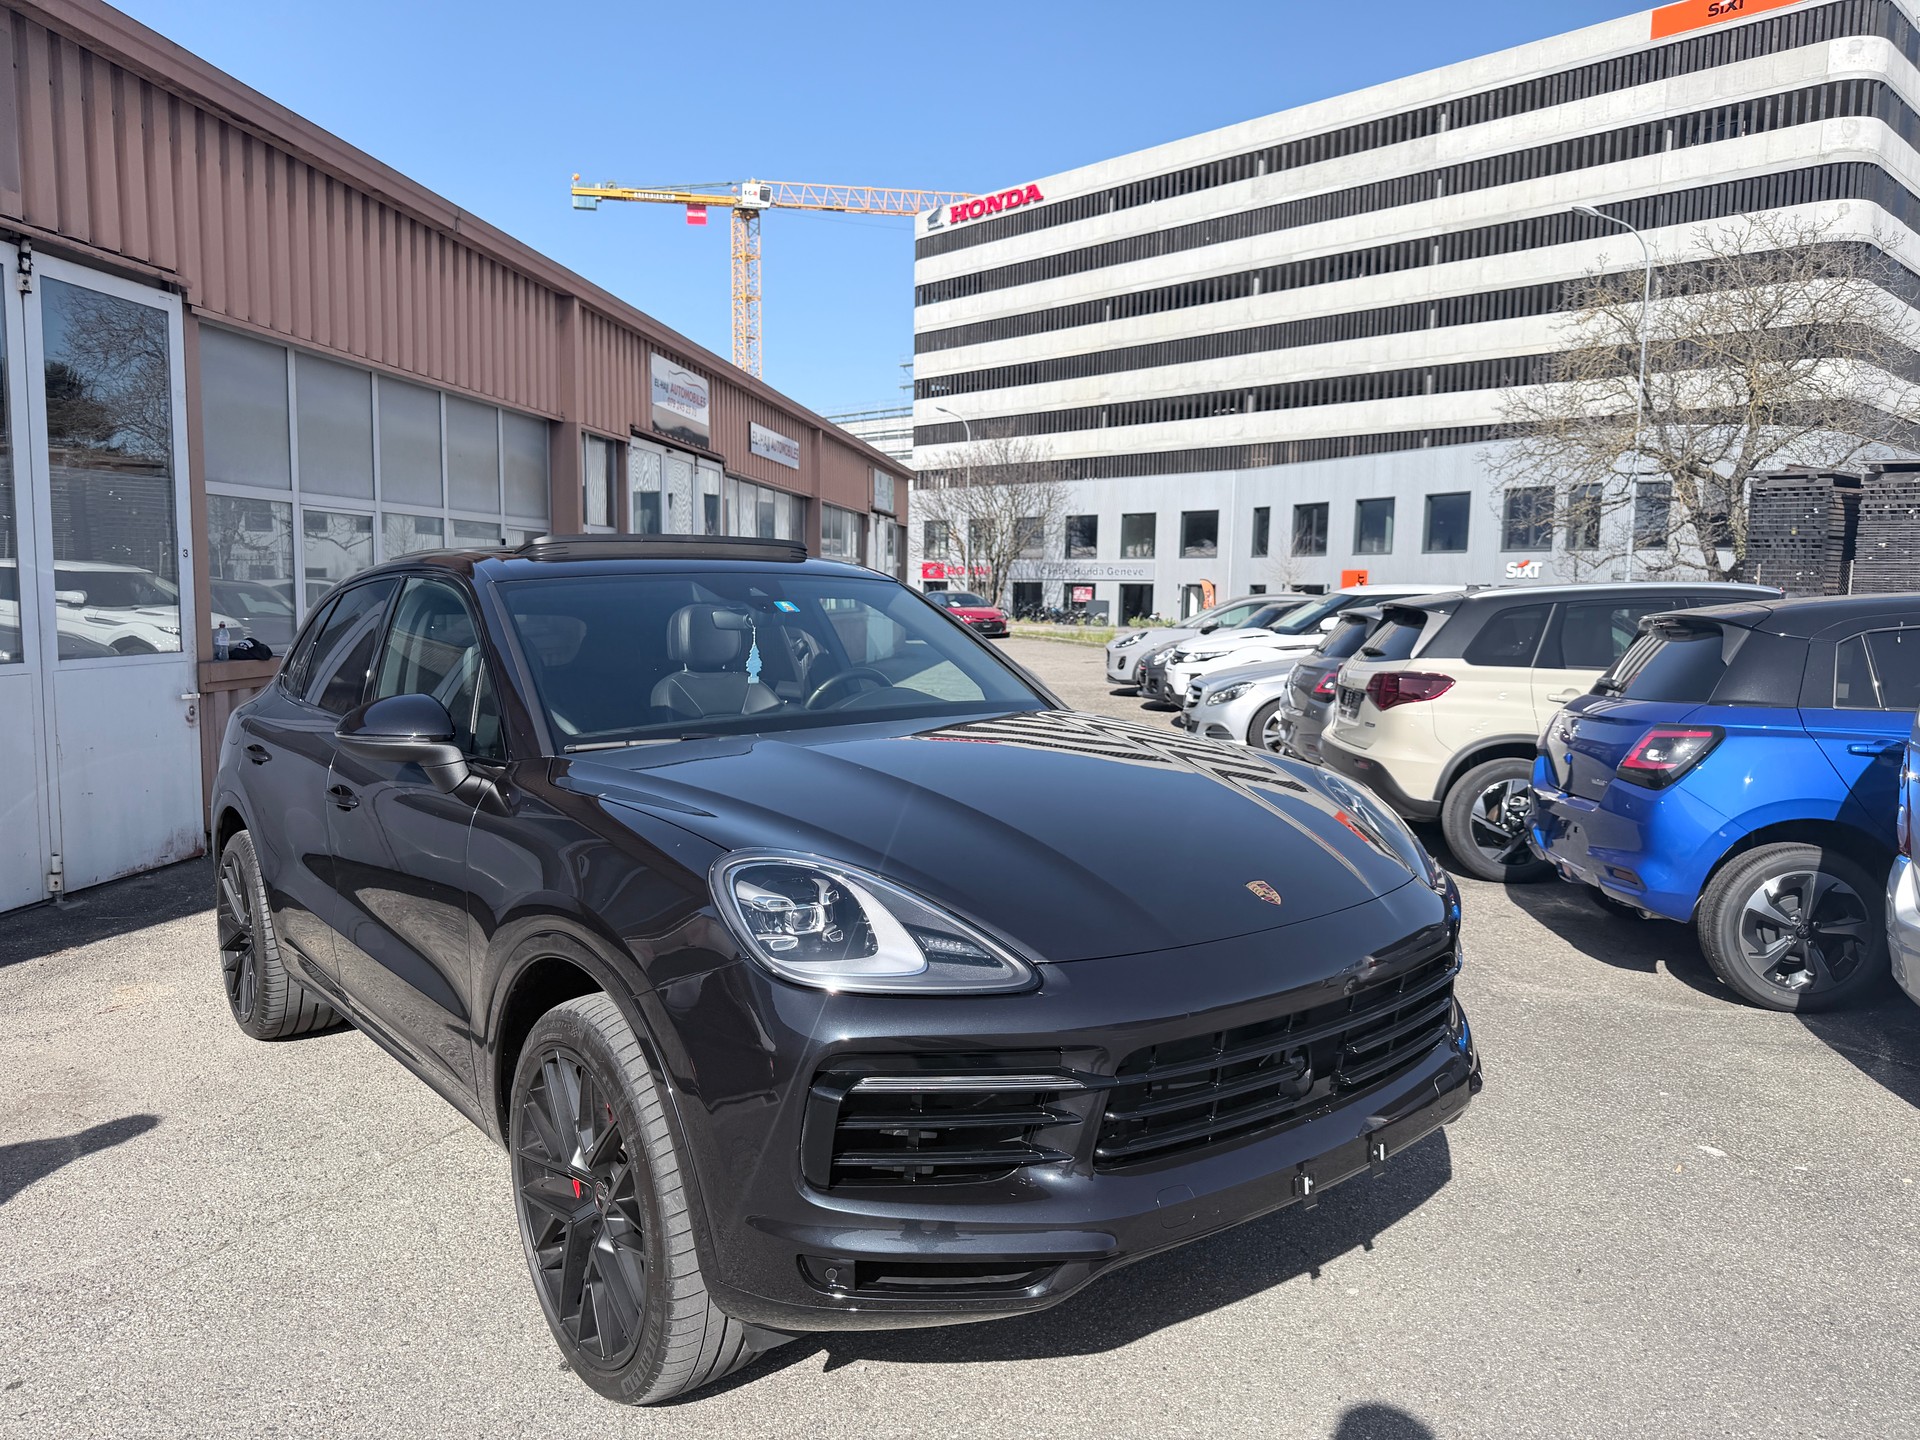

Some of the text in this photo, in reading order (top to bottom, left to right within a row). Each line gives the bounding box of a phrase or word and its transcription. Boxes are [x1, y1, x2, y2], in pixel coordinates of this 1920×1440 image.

[950, 184, 1044, 224] HONDA
[670, 383, 706, 409] AUTOMOBILES
[771, 437, 799, 460] AUTOMOBILES
[183, 549, 188, 558] 3
[1074, 567, 1104, 576] Honda
[622, 1310, 660, 1395] MICHELIN
